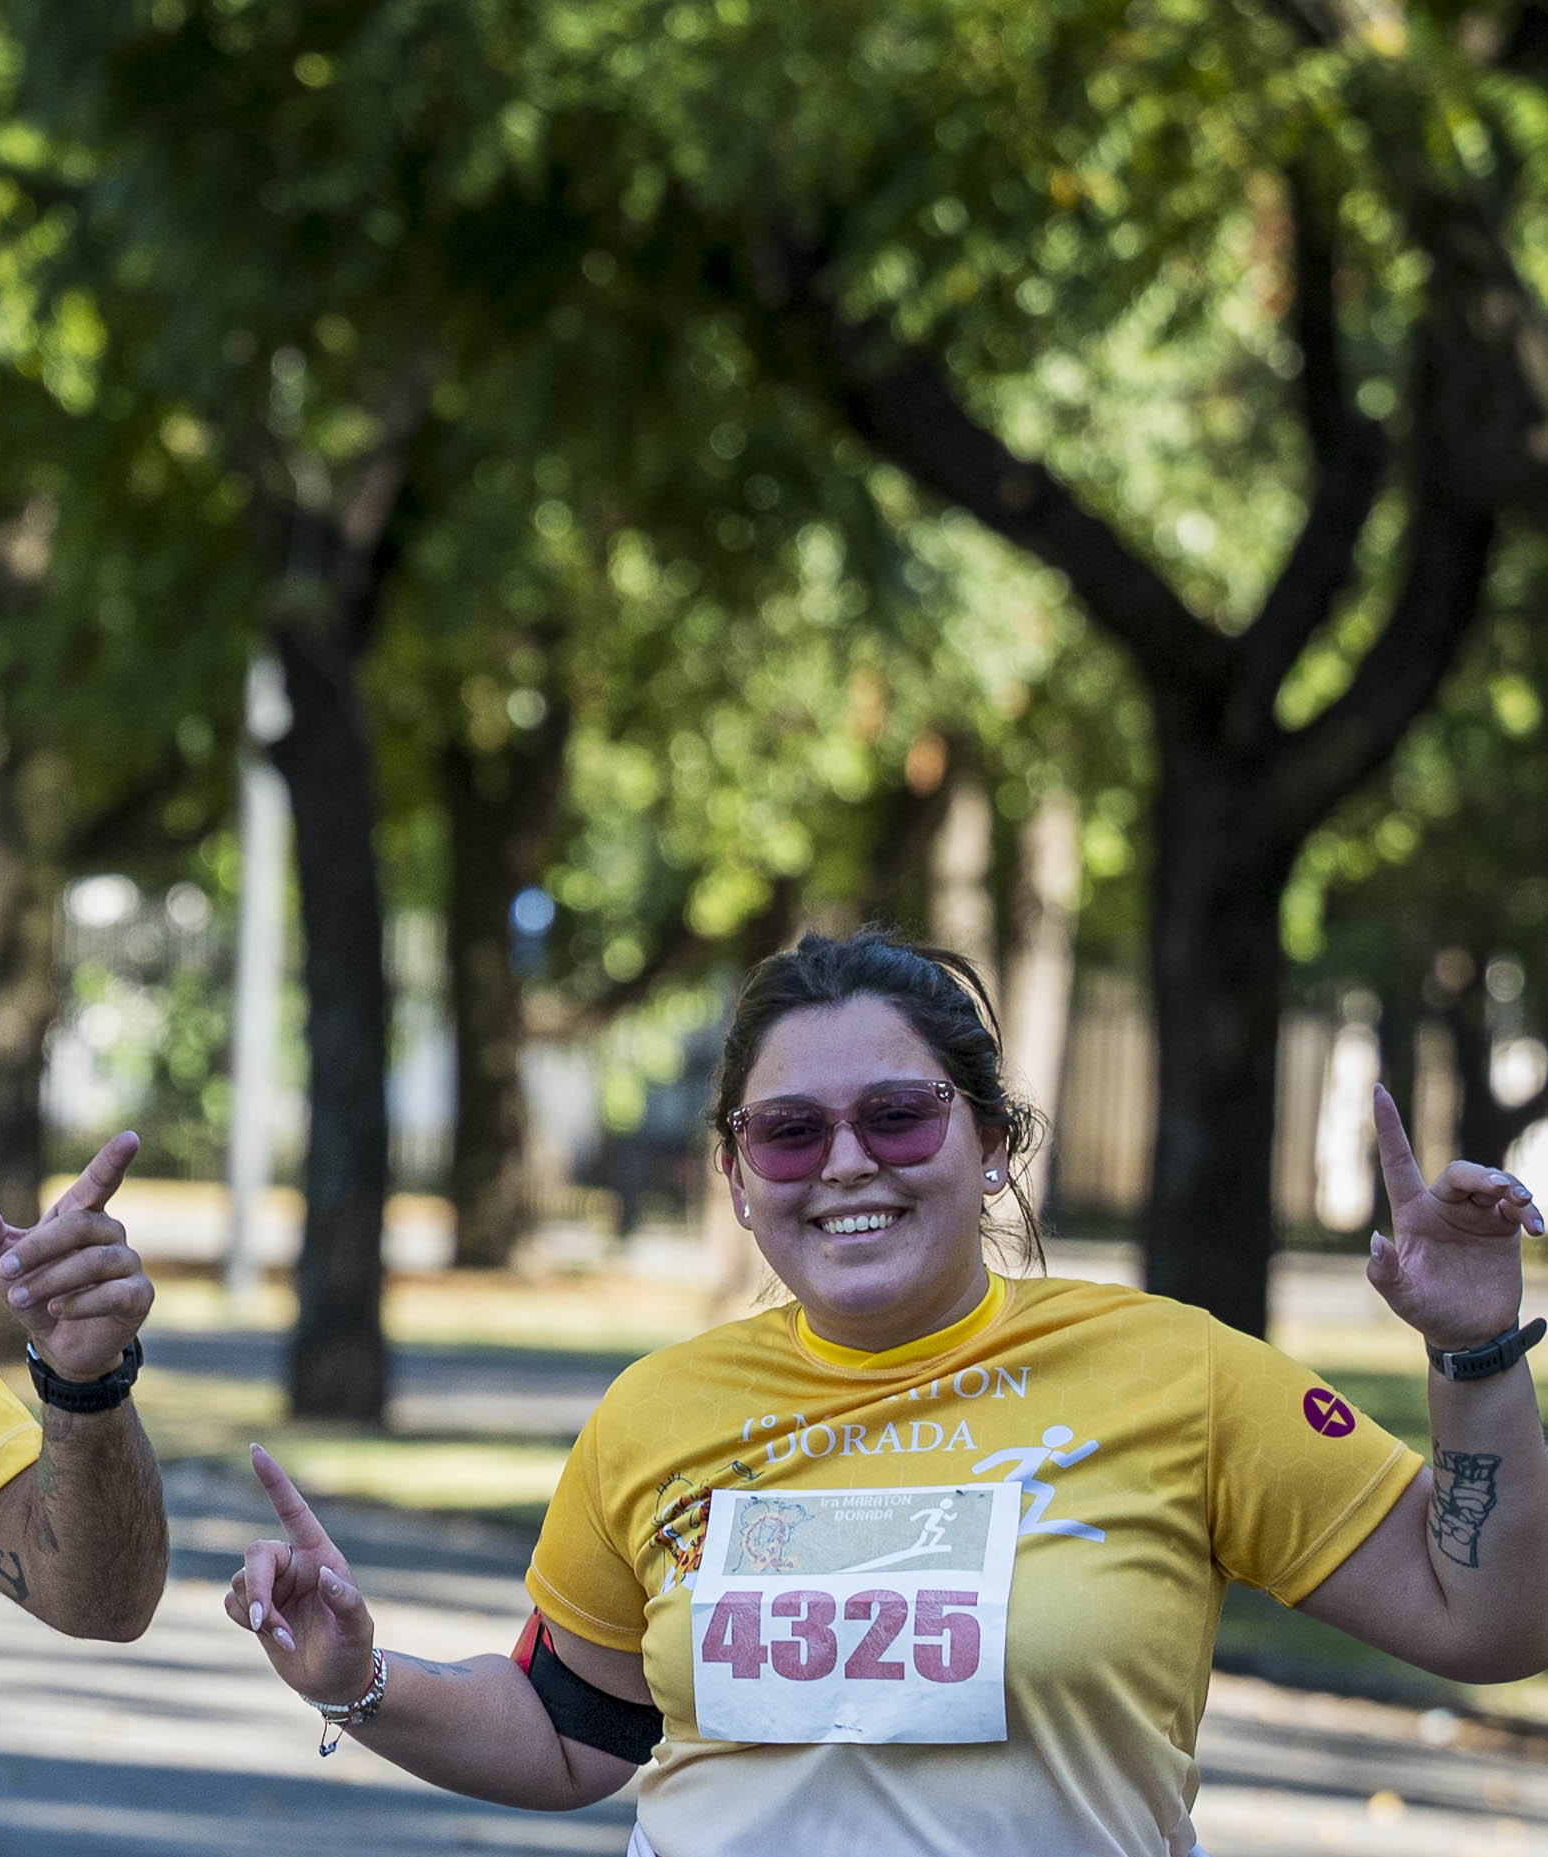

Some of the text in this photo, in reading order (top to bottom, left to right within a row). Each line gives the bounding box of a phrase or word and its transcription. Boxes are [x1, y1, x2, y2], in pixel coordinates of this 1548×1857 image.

[765, 1419, 978, 1464] DORADA
[833, 1509, 894, 1521] DORADA
[842, 1494, 913, 1507] MARATON
[701, 1589, 981, 1684] 4325
